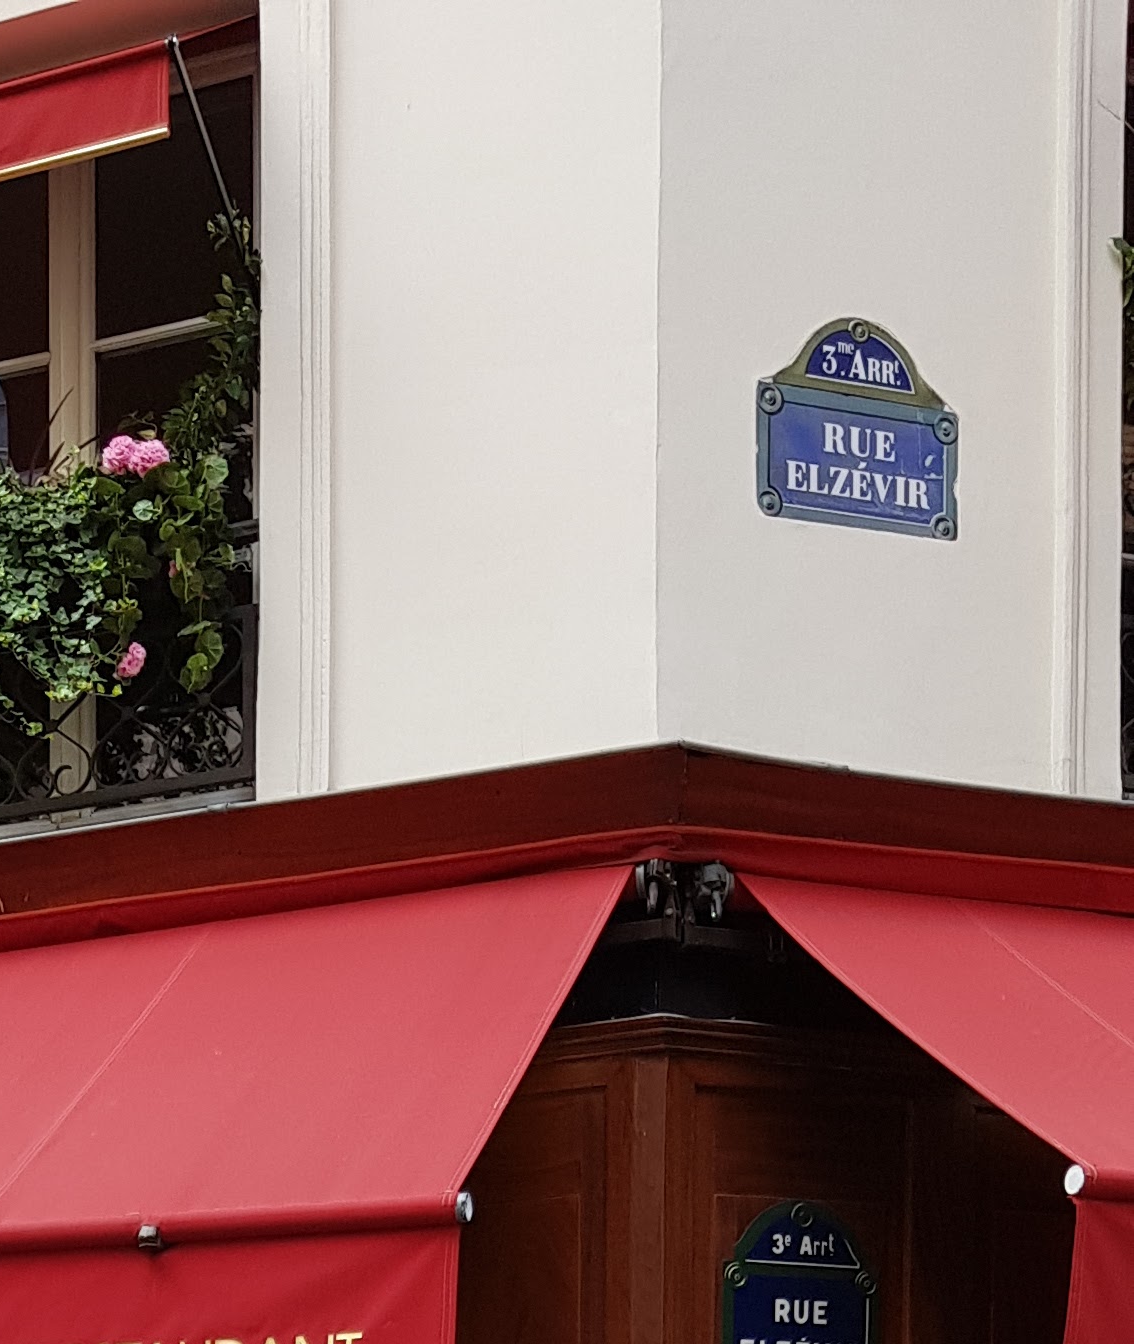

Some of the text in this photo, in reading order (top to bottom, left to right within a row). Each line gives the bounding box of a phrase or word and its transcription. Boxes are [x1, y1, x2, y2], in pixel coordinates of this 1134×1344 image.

[823, 422, 896, 462] RUE
[786, 459, 931, 510] ELZÉVIR
[774, 1298, 828, 1325] RUE
